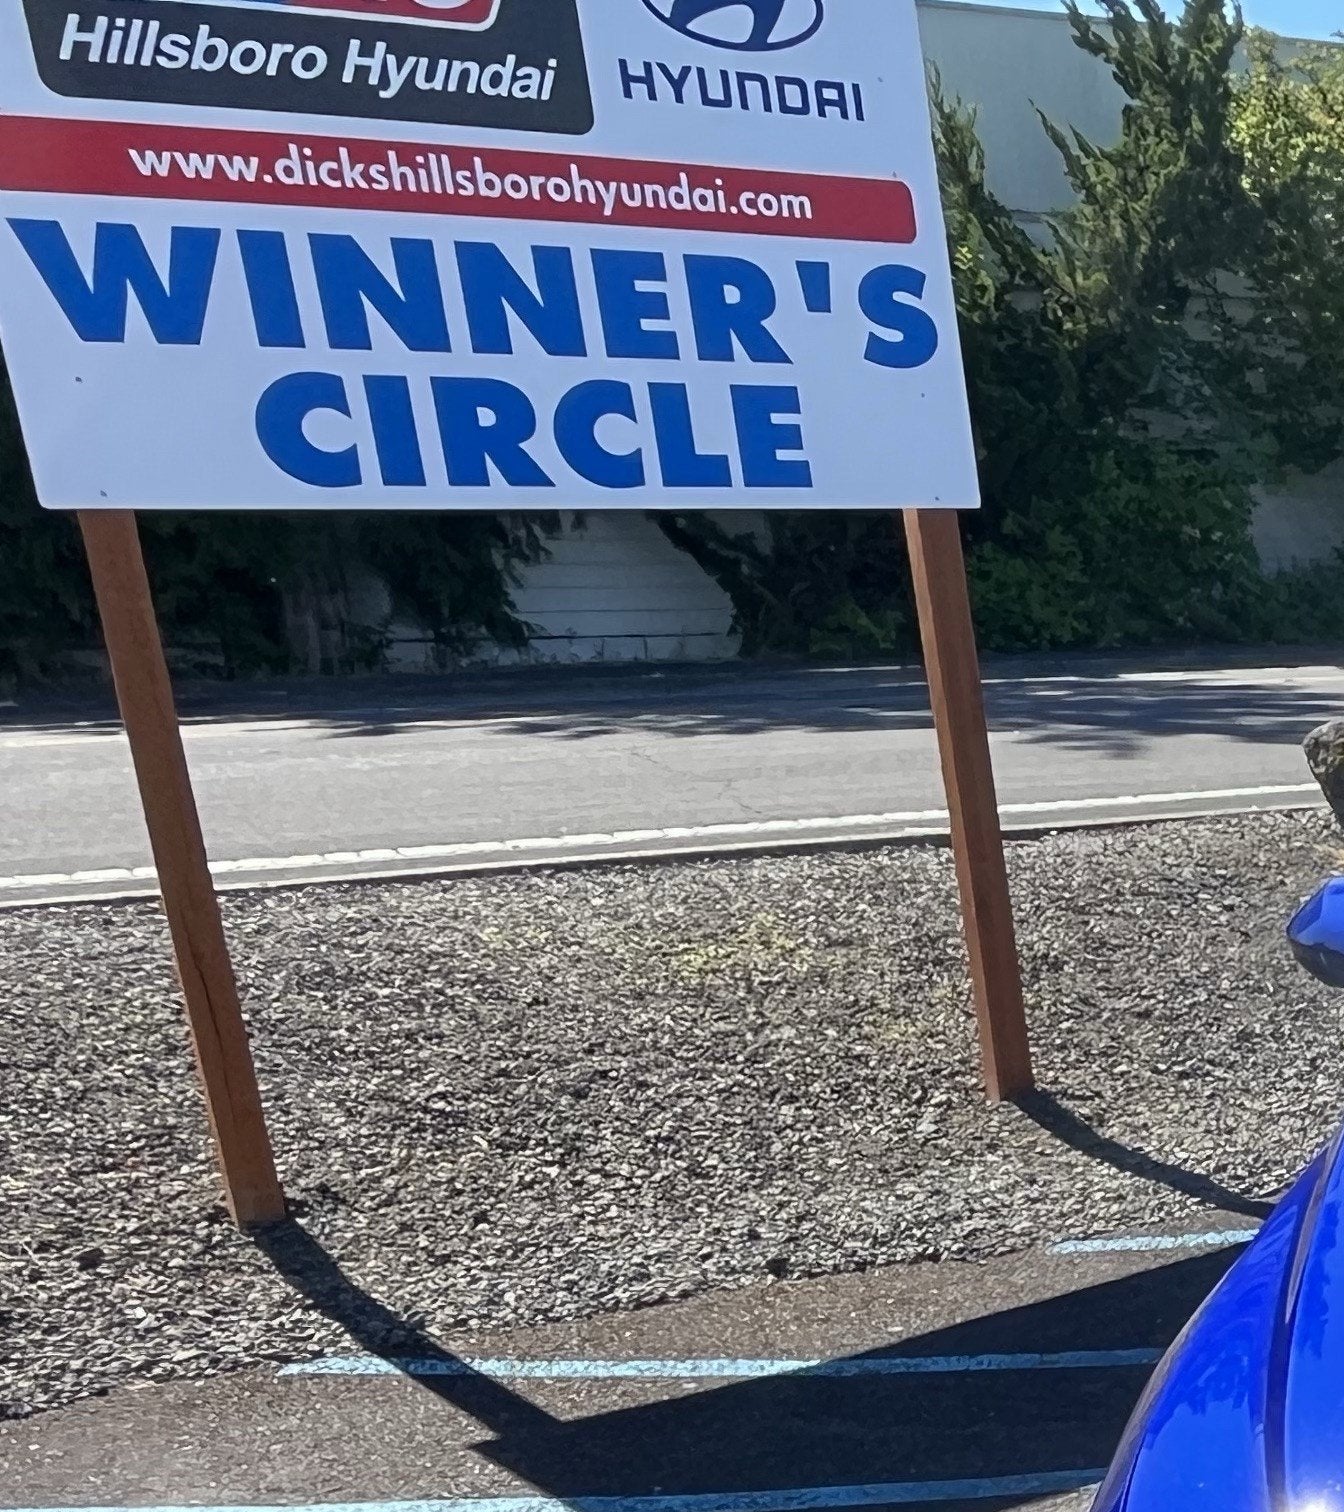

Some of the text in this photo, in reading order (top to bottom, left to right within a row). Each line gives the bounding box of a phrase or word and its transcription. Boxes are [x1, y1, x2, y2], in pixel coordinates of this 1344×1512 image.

[59, 14, 557, 102] Hillsboro Hyundai
[618, 58, 866, 122] HYUNDAI
[127, 142, 814, 220] www.dickshillsborohyundai.com
[4, 217, 939, 369] WINNER'S
[255, 371, 814, 489] CIRCLE
